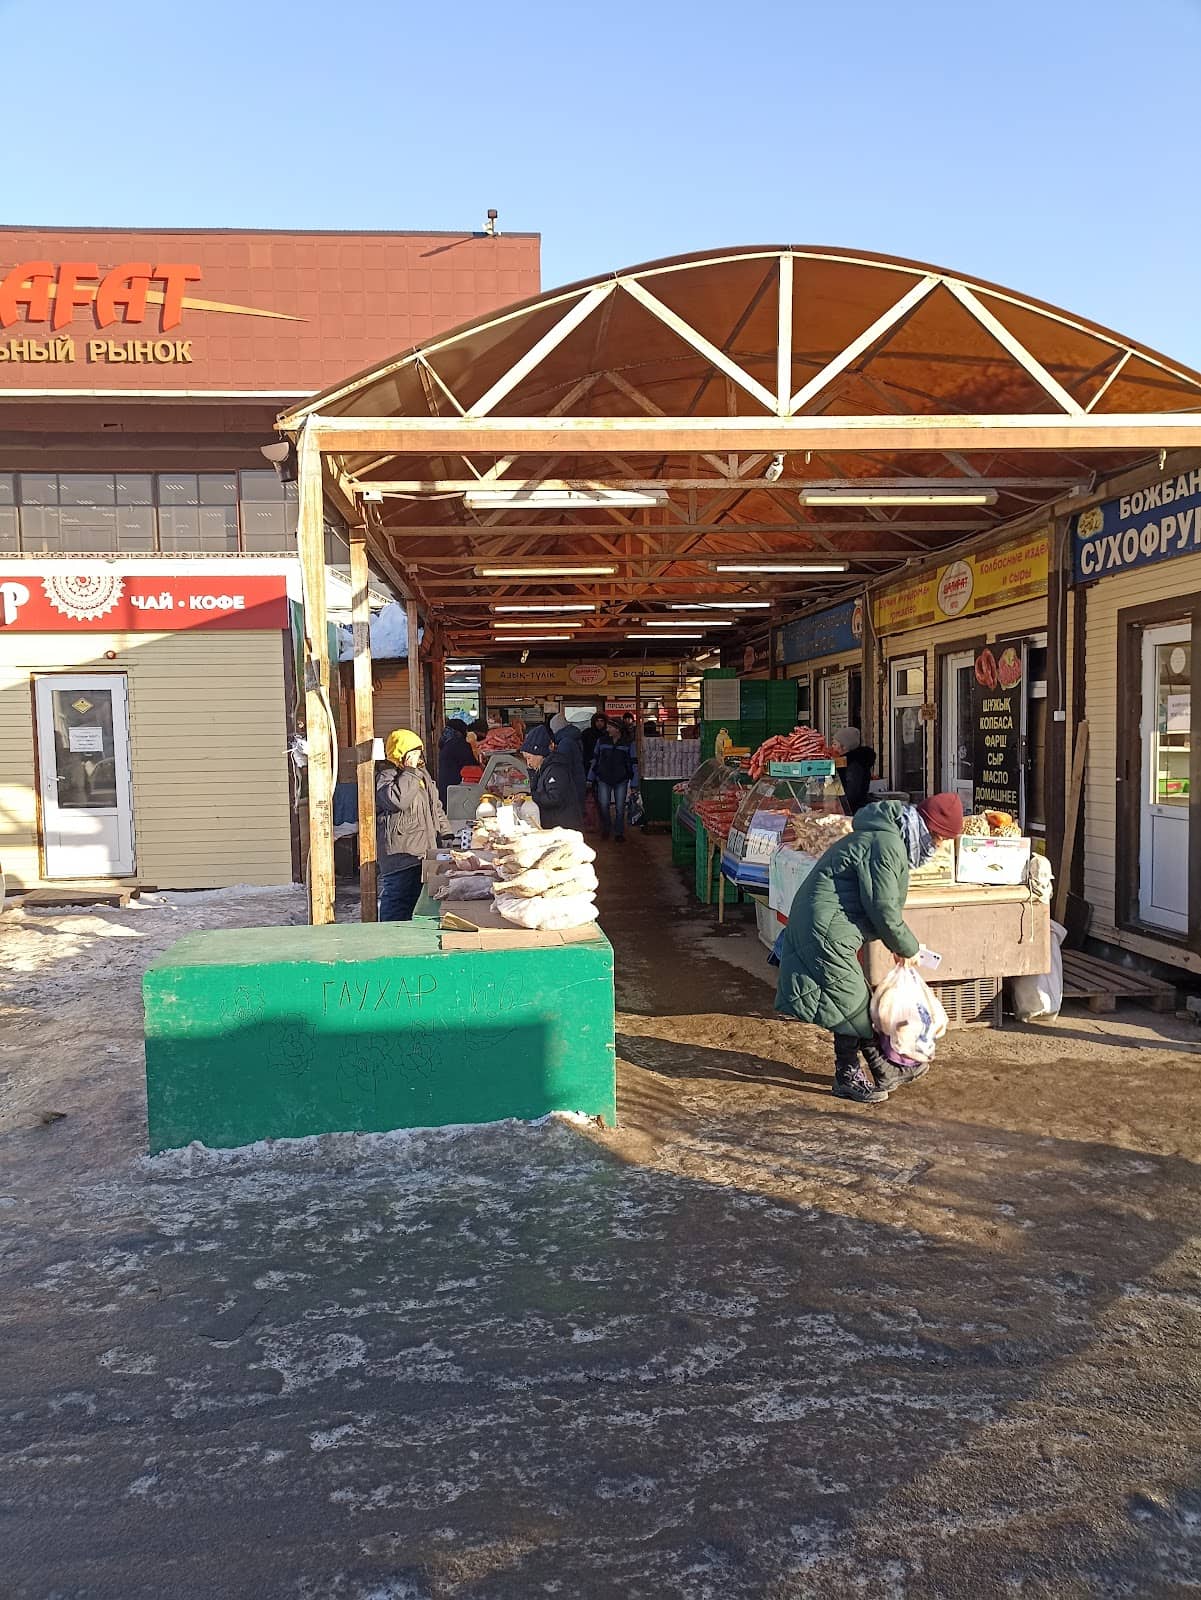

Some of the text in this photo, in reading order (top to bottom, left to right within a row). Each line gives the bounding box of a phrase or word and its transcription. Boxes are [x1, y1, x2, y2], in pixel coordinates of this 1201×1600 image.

[90, 340, 192, 362] РЫНОК
[130, 592, 245, 610] ЧАЙ КОФЕ
[980, 717, 1013, 730] КОЛБАСА
[985, 734, 1007, 747] ФАРШ
[987, 753, 1004, 766] СЫР
[983, 770, 1008, 784] МАСЛО
[975, 787, 1017, 804] ДОМАШНЕЕ
[322, 974, 438, 1016] ГАУХАР
